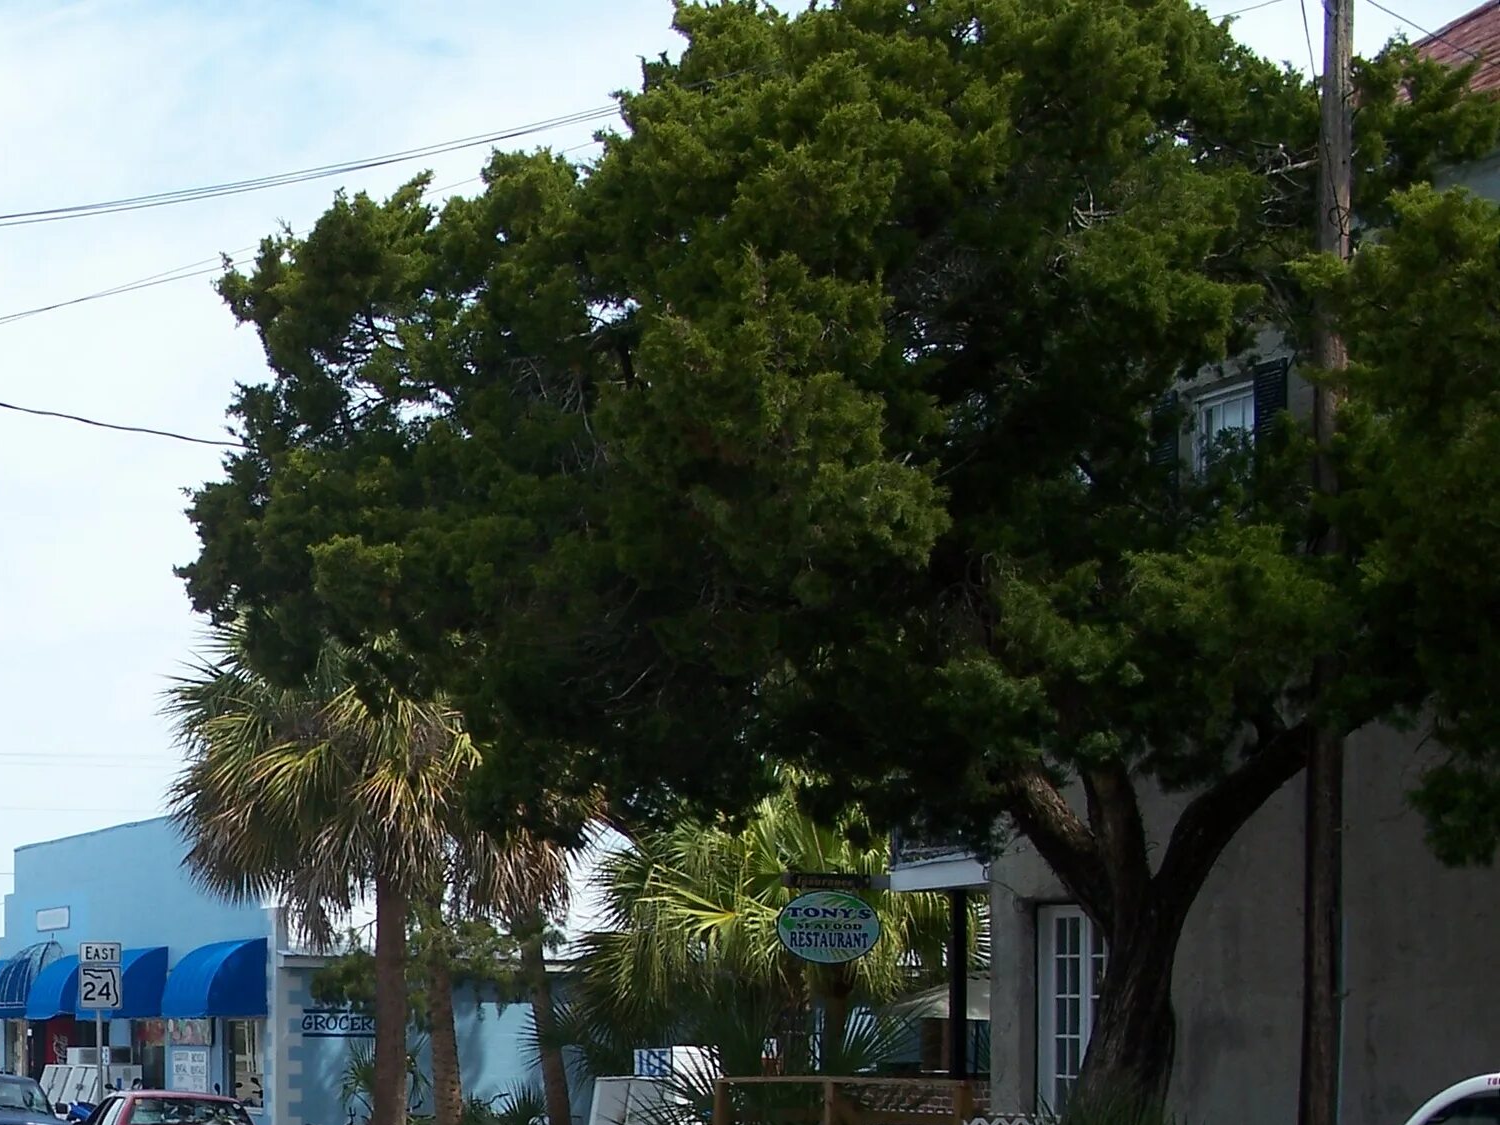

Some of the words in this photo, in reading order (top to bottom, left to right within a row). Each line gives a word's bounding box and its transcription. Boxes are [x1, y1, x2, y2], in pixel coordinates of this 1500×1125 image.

[796, 922, 863, 930] SEAFOOD
[790, 931, 869, 949] RESTAURANT
[85, 948, 115, 960] EAST
[83, 982, 112, 1001] 24
[302, 1015, 377, 1031] GROCER
[638, 1050, 669, 1075] ICE
